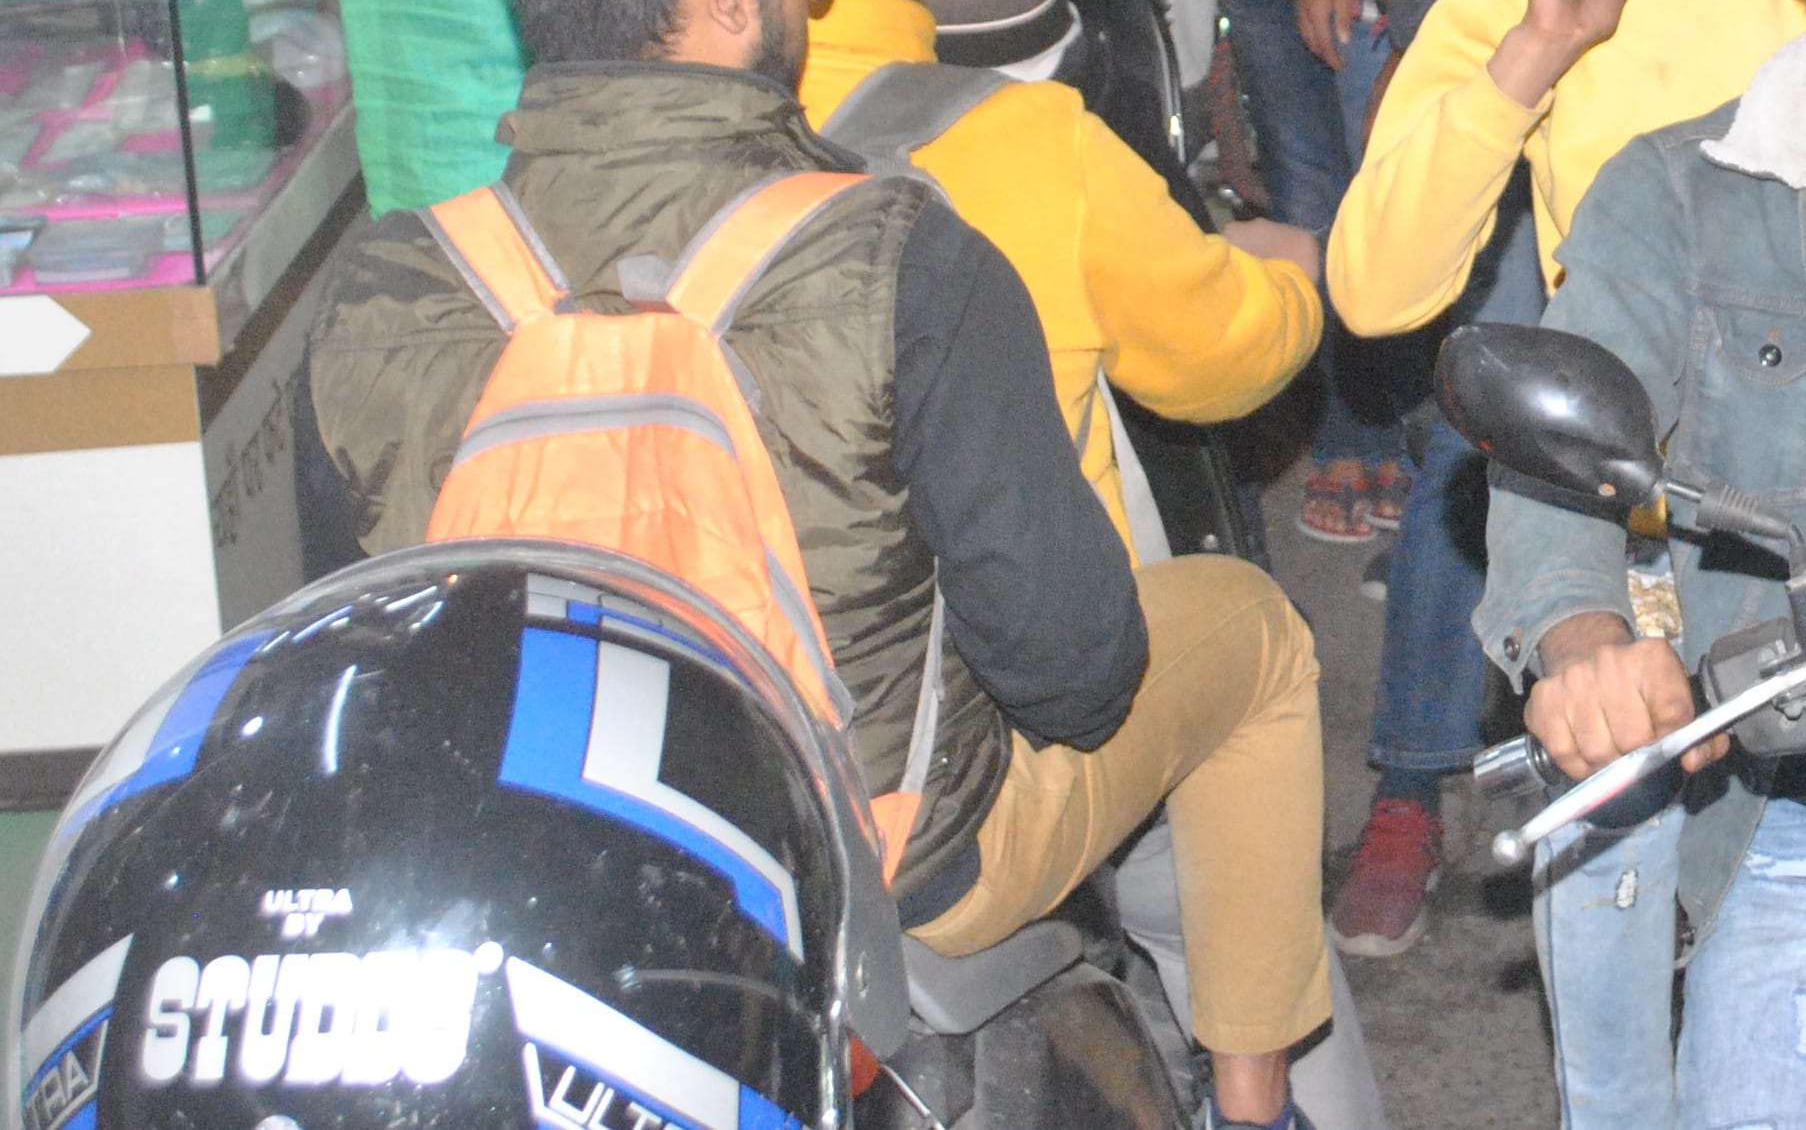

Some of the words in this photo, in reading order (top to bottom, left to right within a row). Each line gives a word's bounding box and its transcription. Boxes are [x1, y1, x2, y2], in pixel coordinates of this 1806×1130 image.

[262, 888, 353, 914] ULTRA
[281, 912, 326, 938] BY
[142, 948, 480, 1084] STUDDS
[549, 1064, 683, 1130] ULT
